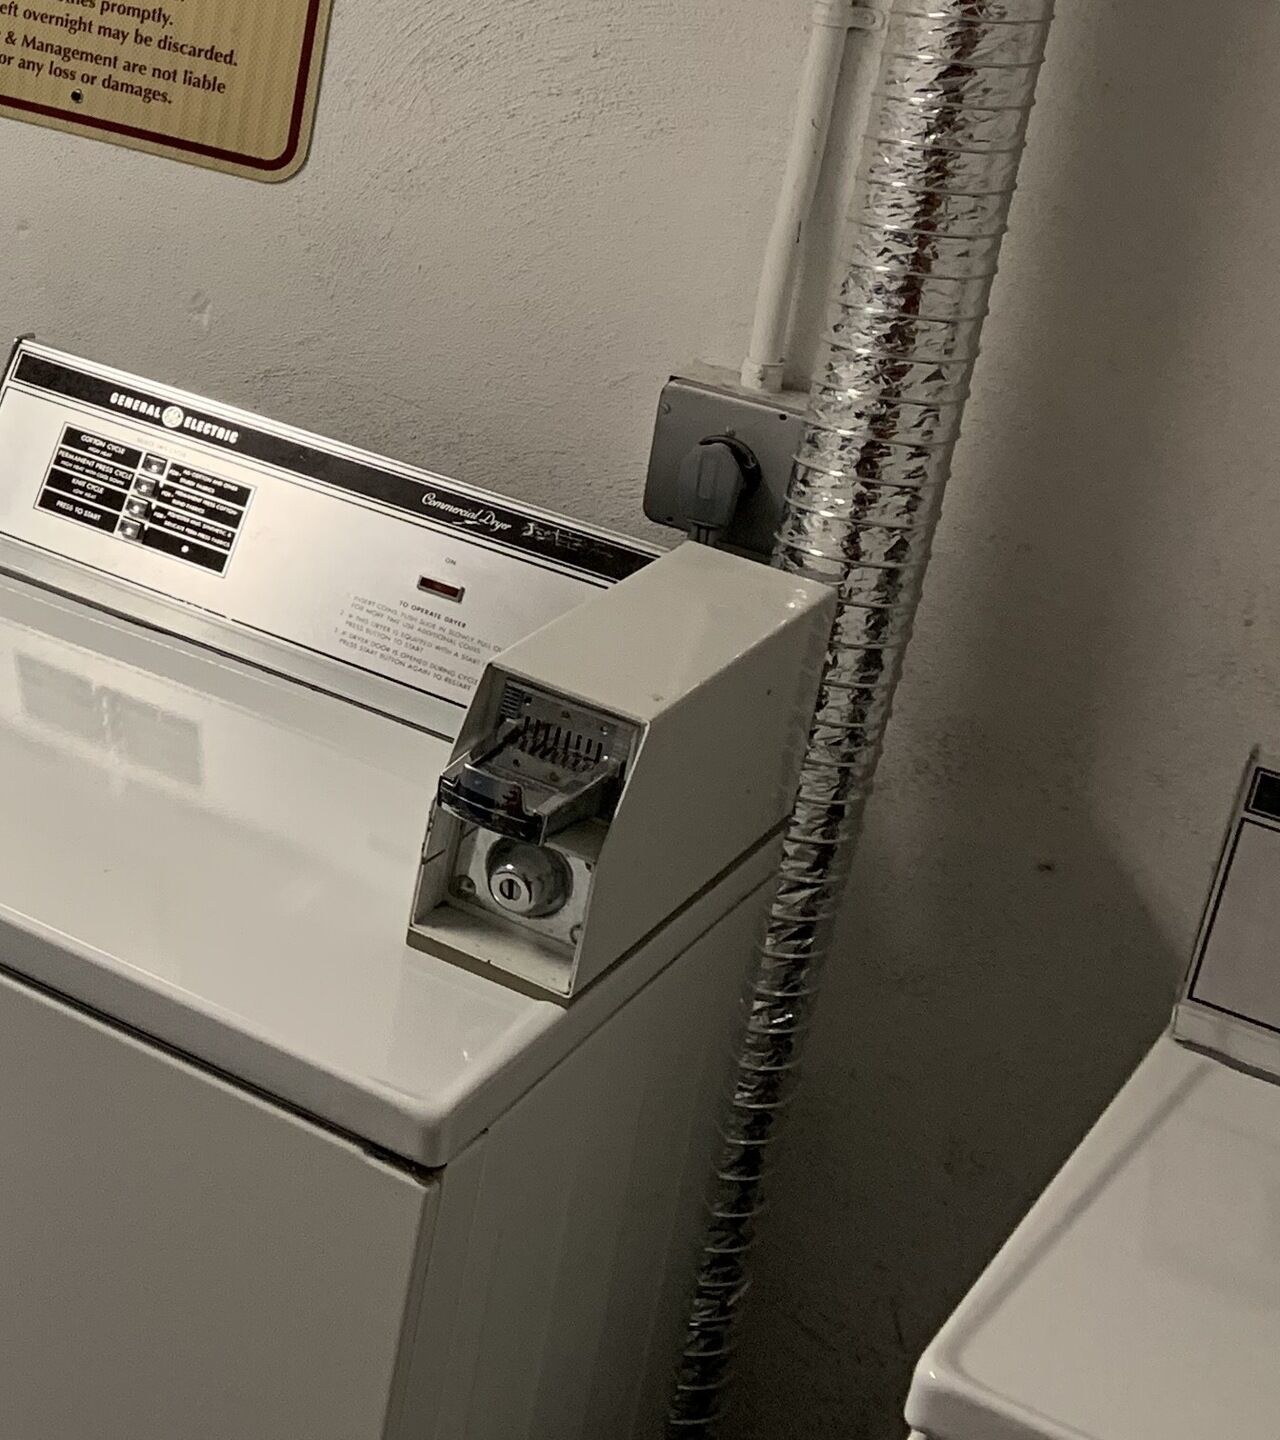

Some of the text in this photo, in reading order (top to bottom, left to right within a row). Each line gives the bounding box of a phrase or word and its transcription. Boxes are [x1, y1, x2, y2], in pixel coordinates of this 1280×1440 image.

[99, 0, 173, 29] promptly.
[22, 8, 93, 35] overnight
[97, 24, 130, 46] may
[133, 27, 153, 47] be
[156, 34, 238, 67] discarded.
[4, 30, 17, 46] &
[20, 34, 118, 69] Management
[122, 60, 147, 76] are
[151, 67, 178, 83] not
[182, 69, 226, 94] liable
[17, 57, 44, 78] any
[48, 60, 77, 81] loss
[79, 73, 98, 88] or
[101, 73, 172, 104] damages.
[109, 392, 239, 443] GENERAL ELECTRIC
[80, 434, 106, 447] COTTON
[106, 443, 125, 454] CYCLE
[58, 449, 95, 467] PERMANENT
[95, 462, 113, 474] PRESS
[114, 469, 133, 480] CYCLE
[56, 500, 101, 520] PRESS TO START
[421, 493, 512, 532] Commercial Dryer
[399, 600, 467, 628] TO OPERATE DRYER
